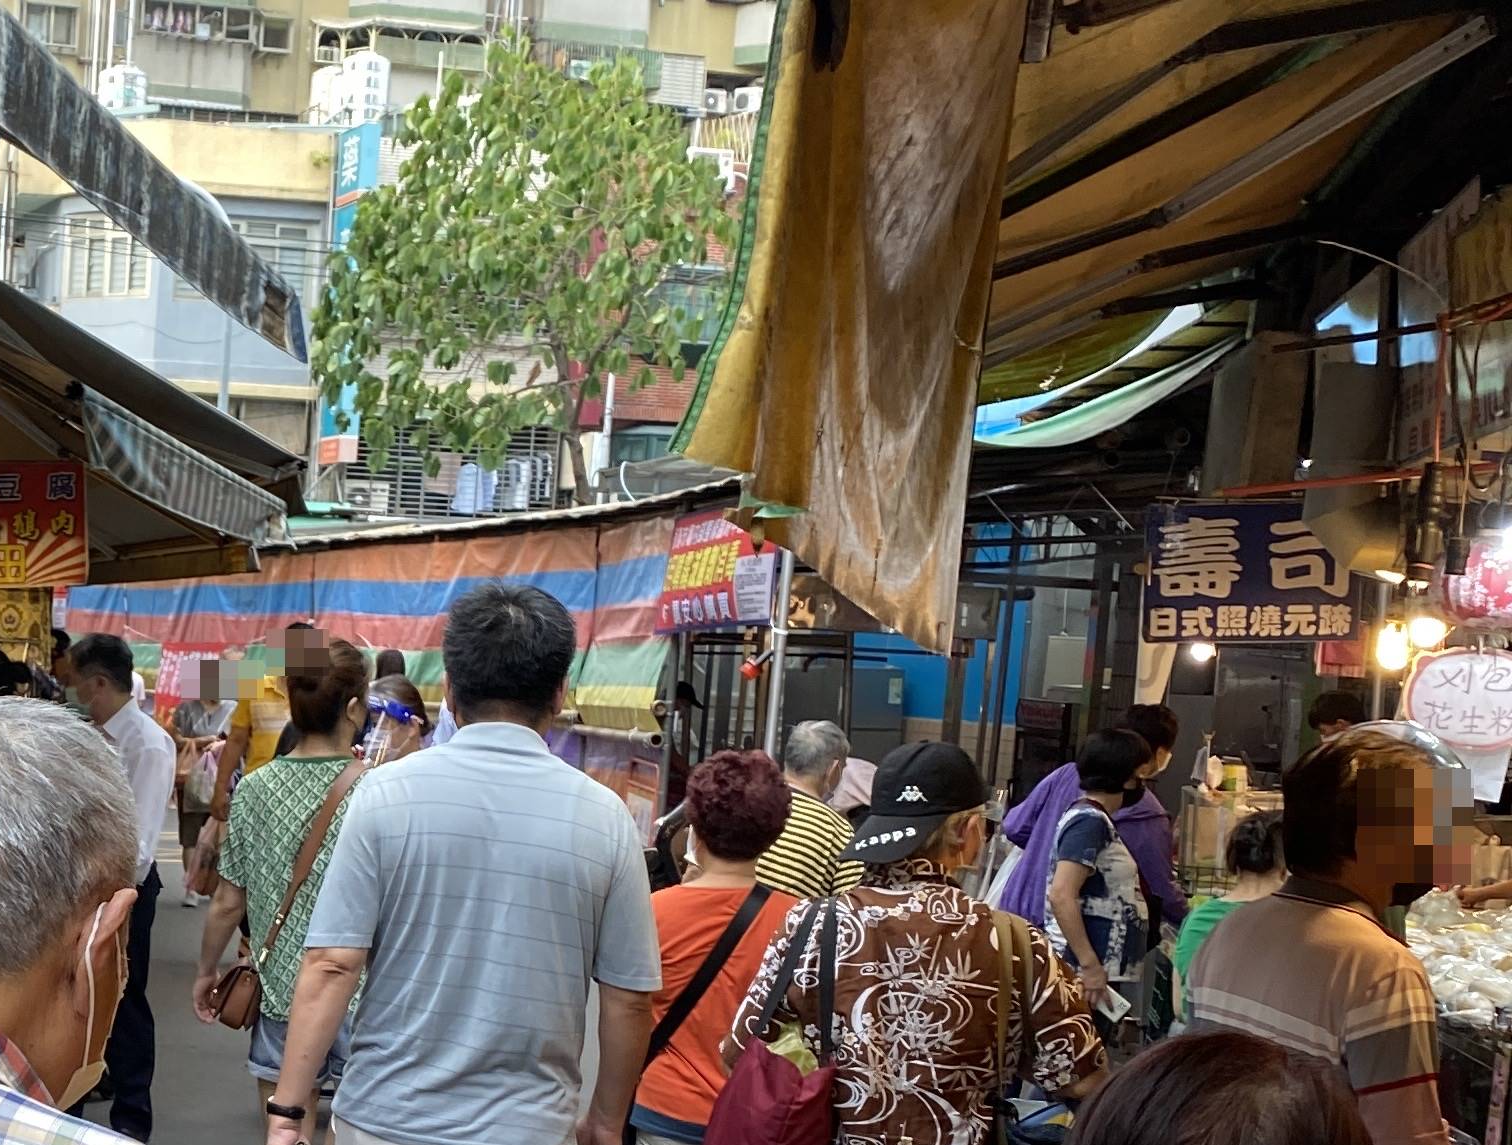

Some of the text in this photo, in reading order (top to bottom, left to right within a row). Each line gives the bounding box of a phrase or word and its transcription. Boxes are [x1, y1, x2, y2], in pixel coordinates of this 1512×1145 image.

[1152, 516, 1352, 600] 壽司
[1149, 603, 1353, 638] 日式照燒元蹄
[1432, 662, 1512, 696] 刈包
[1423, 699, 1512, 737] 花生粉
